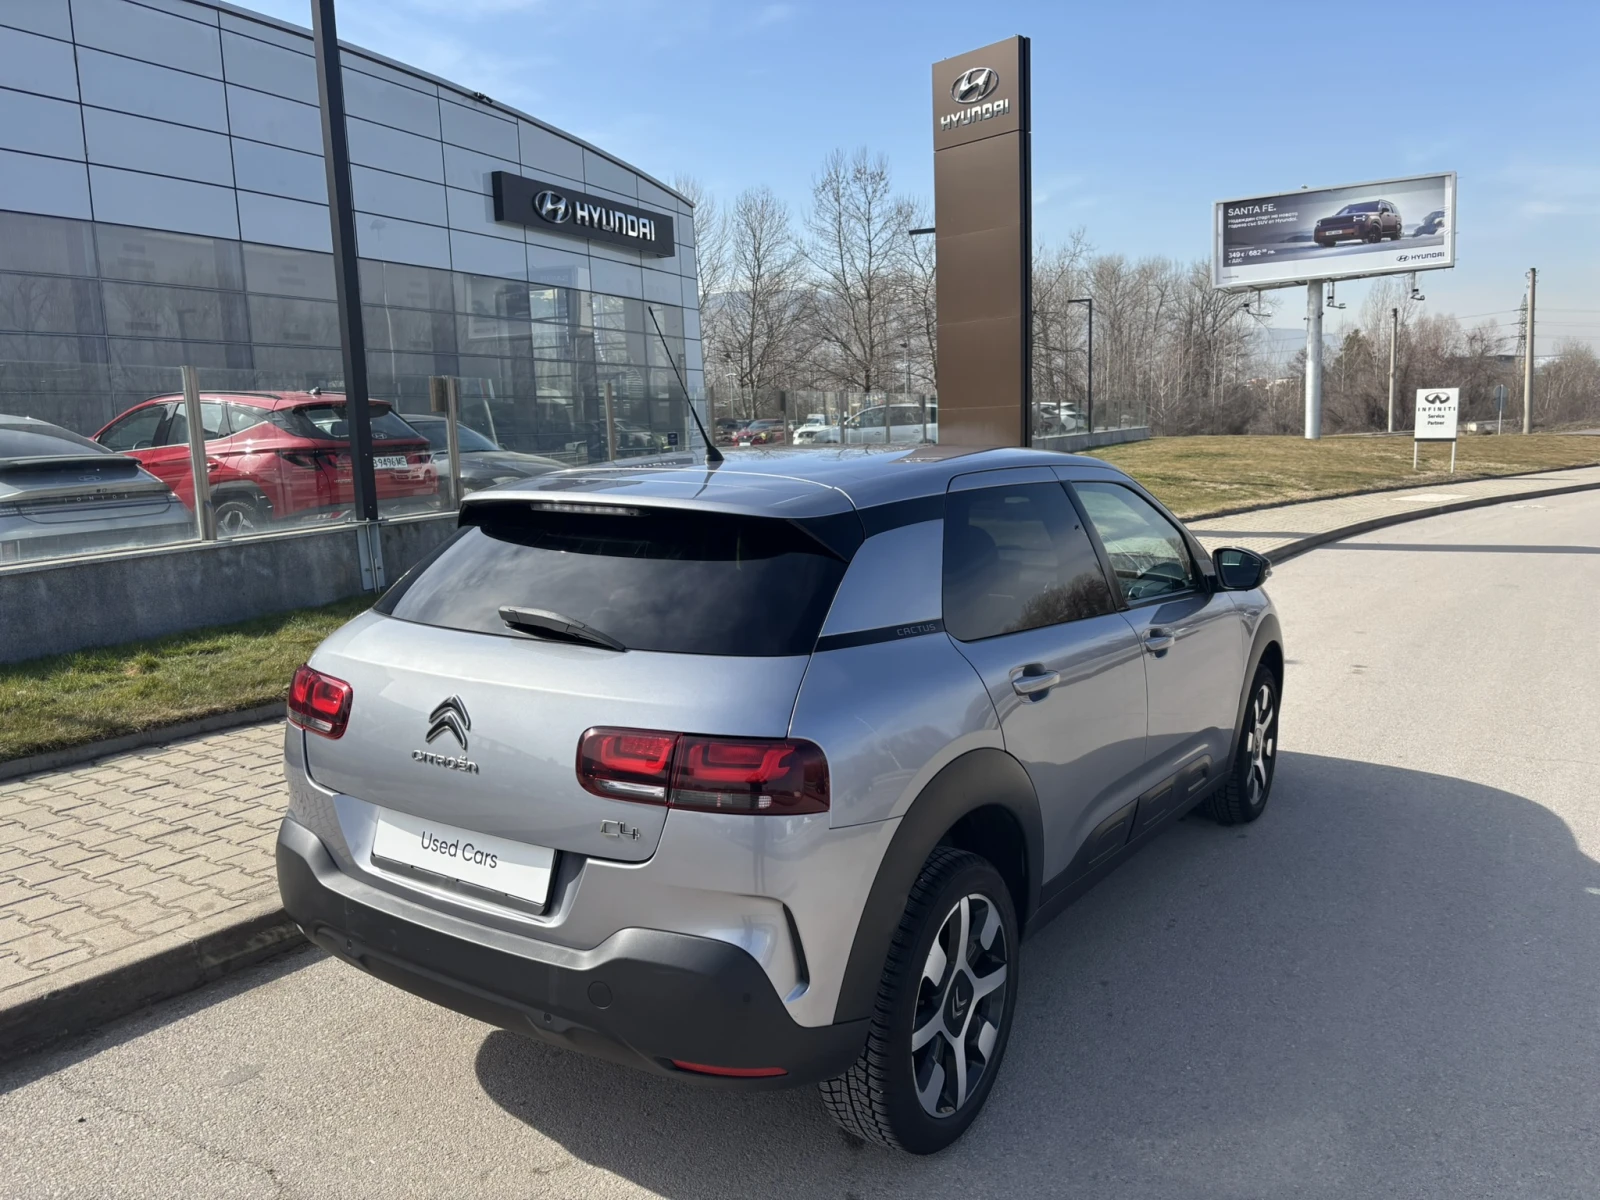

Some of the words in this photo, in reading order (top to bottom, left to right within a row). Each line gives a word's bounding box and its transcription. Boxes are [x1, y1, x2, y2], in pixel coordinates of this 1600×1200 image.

[940, 98, 1010, 131] HYUNDAI
[1228, 205, 1260, 216] SANTA
[1262, 203, 1277, 212] FE.
[575, 201, 656, 242] HYUNDAI
[1228, 251, 1240, 259] 349
[1411, 251, 1445, 260] HYUNDAI
[897, 623, 936, 636] CACTUS
[601, 819, 641, 841] C4
[420, 831, 460, 858] Used
[462, 842, 498, 869] Cars
